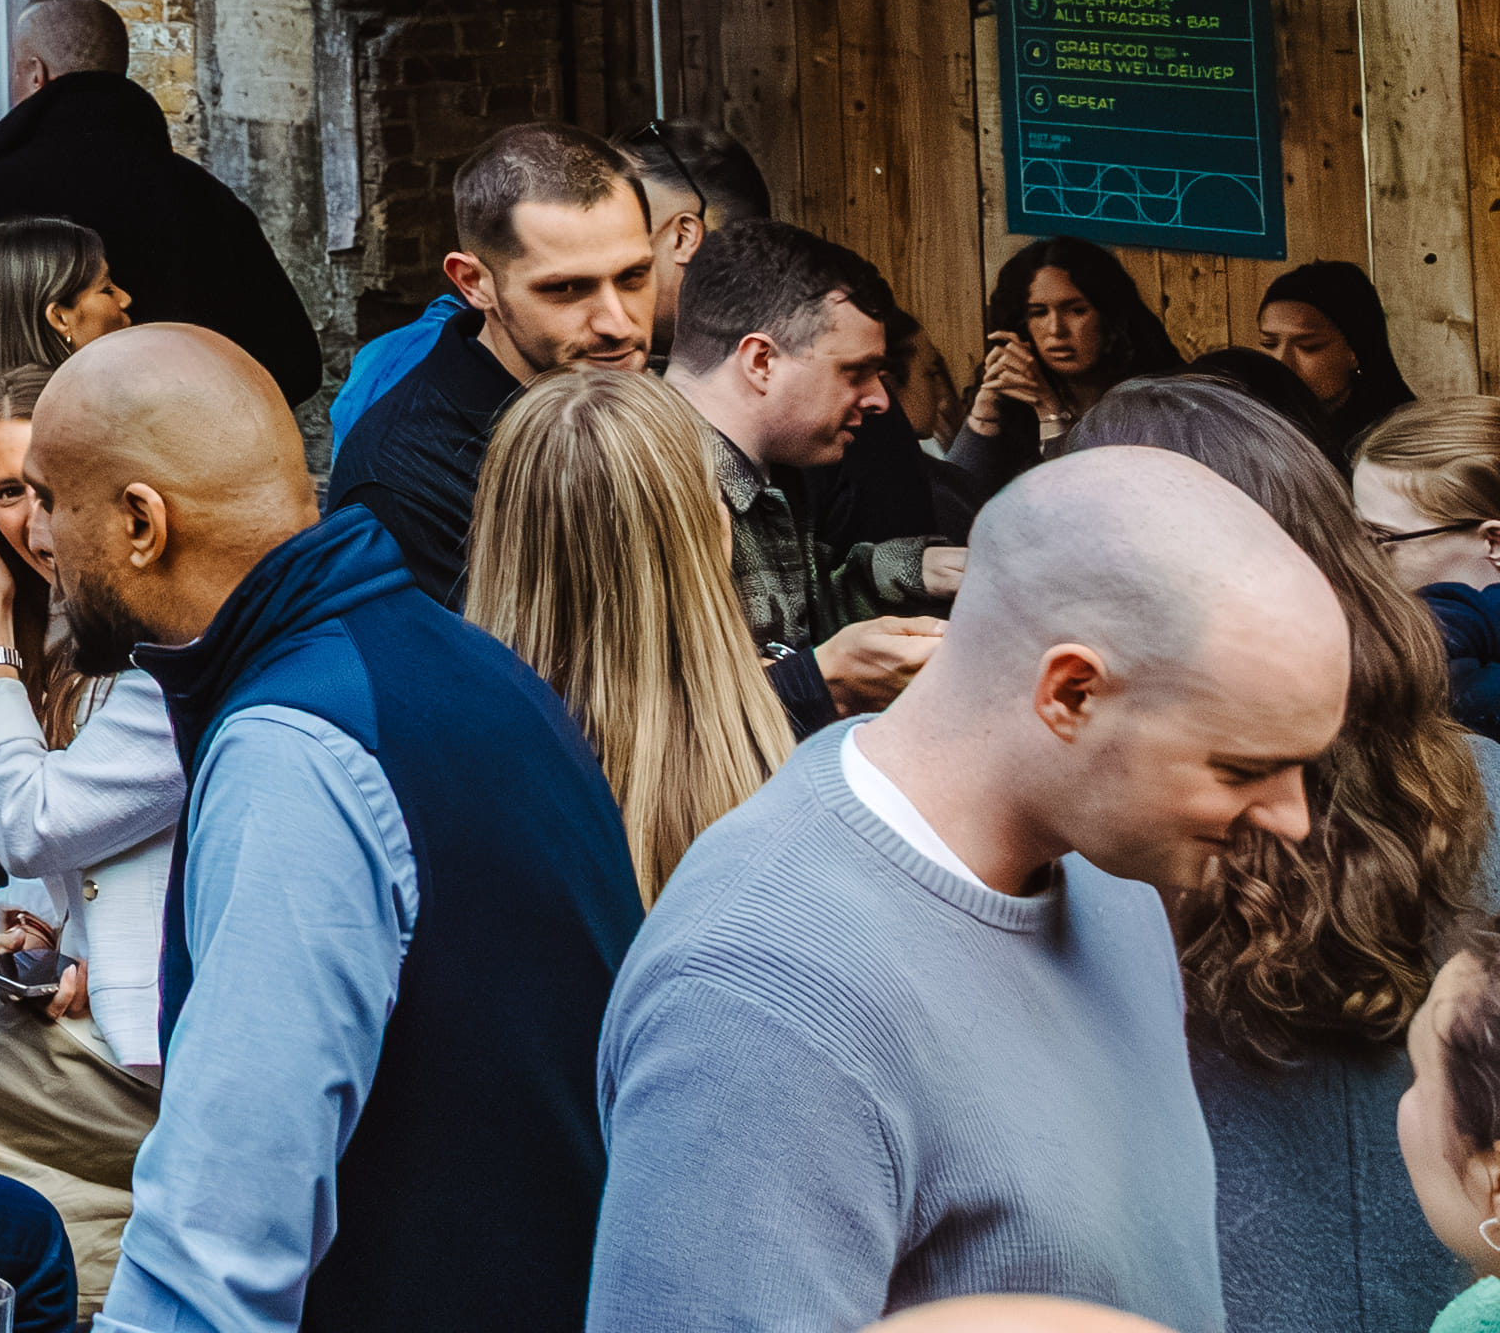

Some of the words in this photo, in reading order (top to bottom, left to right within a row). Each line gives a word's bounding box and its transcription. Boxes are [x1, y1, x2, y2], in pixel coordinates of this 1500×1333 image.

[1054, 8, 1081, 23] ALL
[1099, 11, 1172, 28] TRADERS
[1187, 15, 1221, 29] BAR
[1055, 40, 1100, 55] GRAB
[1103, 42, 1149, 59] FOOD
[1056, 56, 1113, 73] DRINKS
[1167, 63, 1236, 81] DELIVER
[1056, 93, 1118, 111] REPEAT
